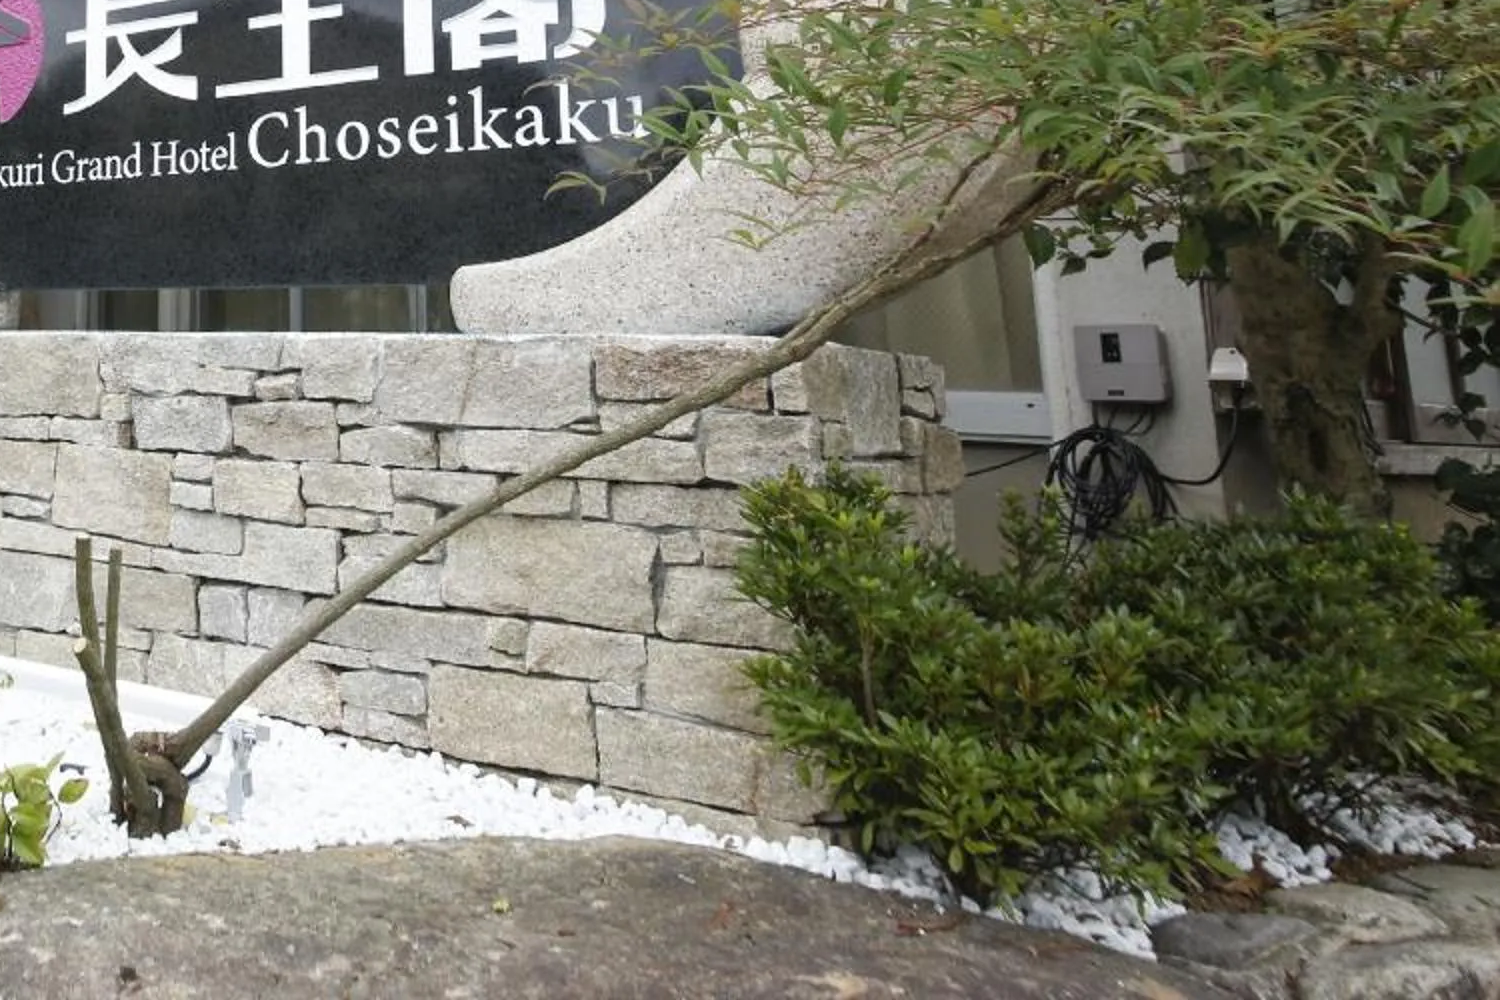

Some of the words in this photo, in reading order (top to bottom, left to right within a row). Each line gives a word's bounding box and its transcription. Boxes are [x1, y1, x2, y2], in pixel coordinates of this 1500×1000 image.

[50, 141, 143, 184] Grand
[150, 131, 238, 177] Hotel
[247, 81, 651, 168] Choseikaku
